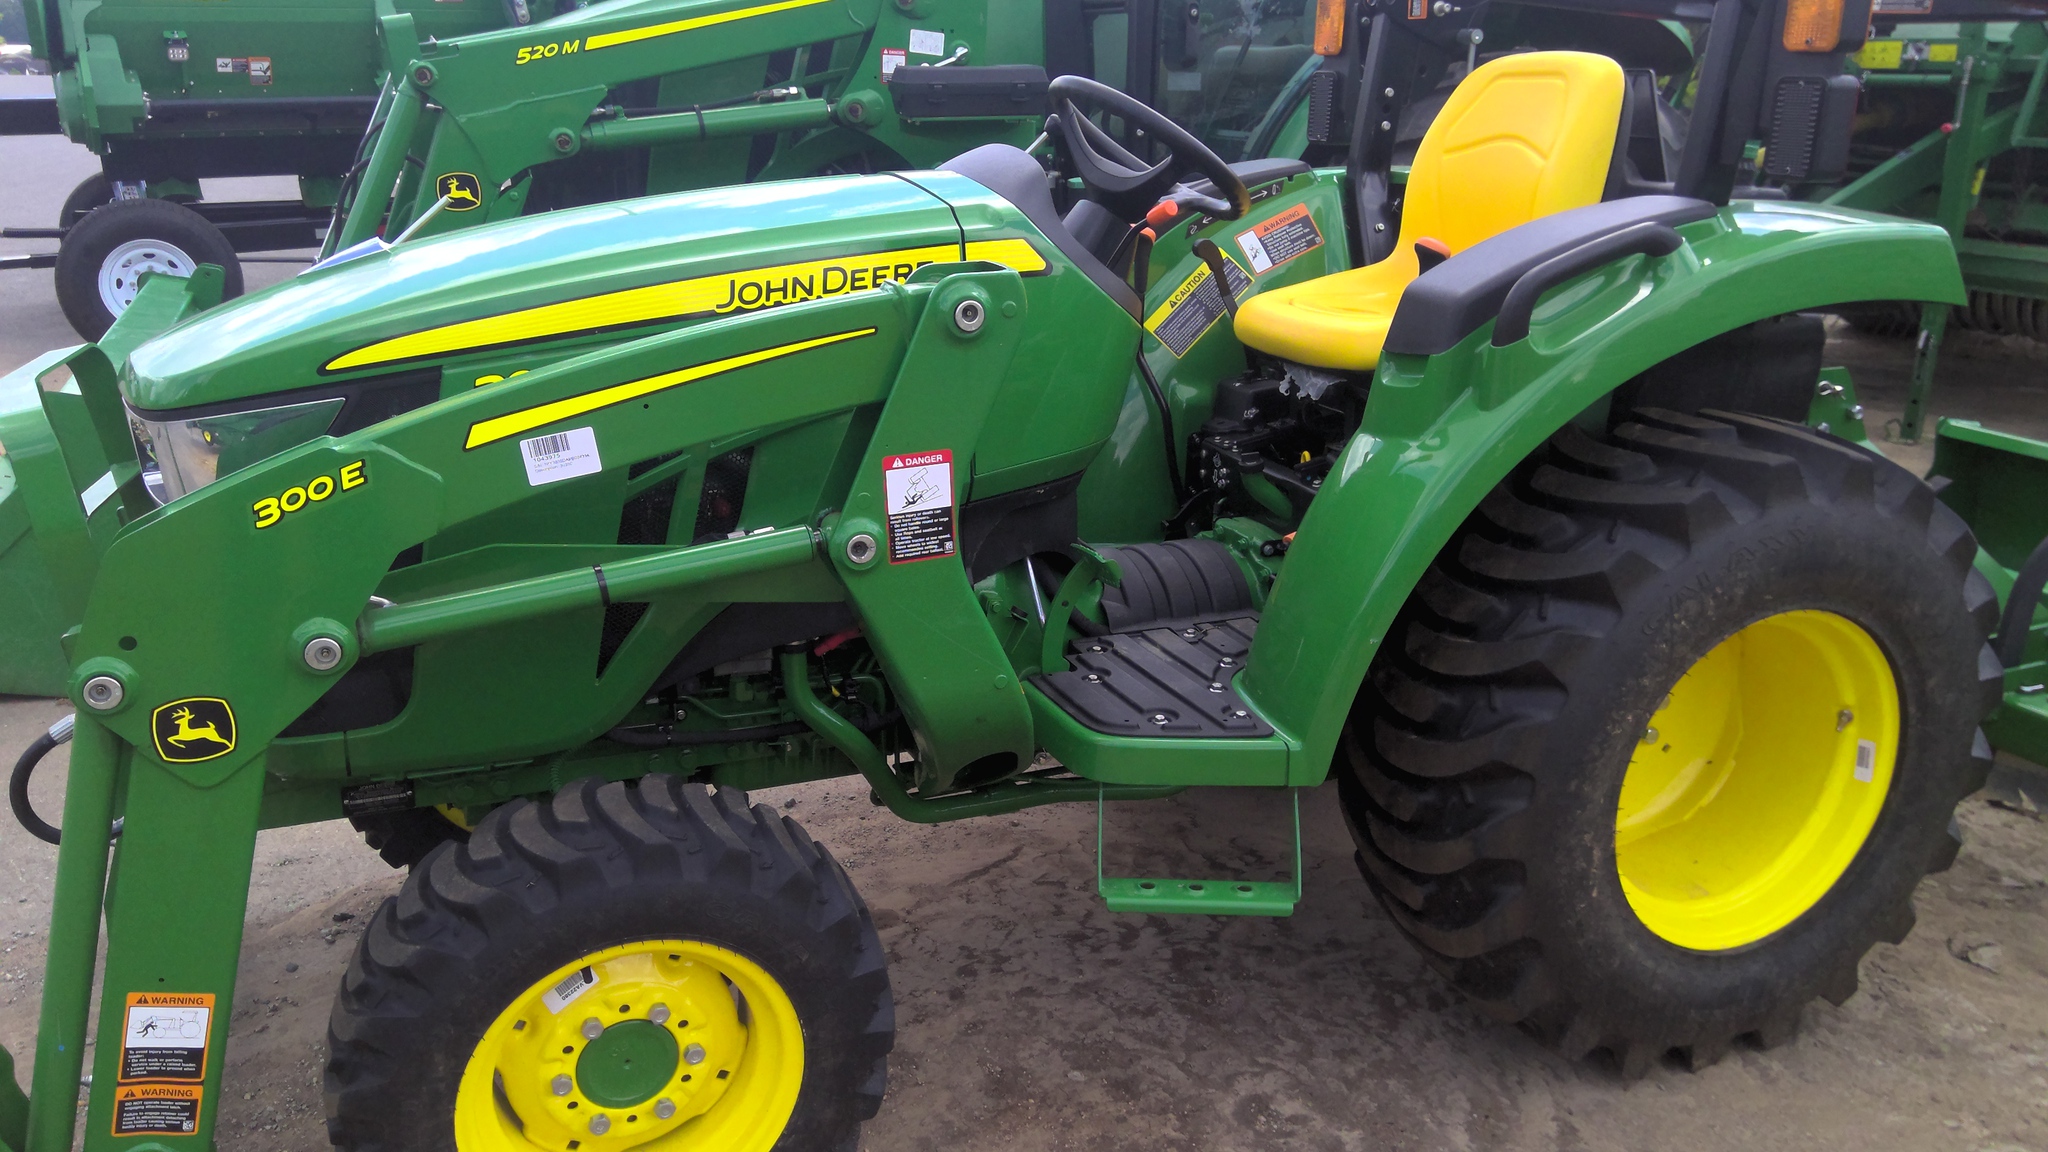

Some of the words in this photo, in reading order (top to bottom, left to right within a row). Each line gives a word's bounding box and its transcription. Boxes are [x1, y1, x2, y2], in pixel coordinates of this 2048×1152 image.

[516, 43, 559, 64] 520
[562, 40, 580, 54] M
[1269, 211, 1300, 229] WARNING
[716, 274, 814, 309] JOHN
[822, 261, 934, 293] DEER
[1175, 270, 1206, 302] CAUTION
[906, 454, 943, 466] DANGER
[253, 475, 336, 529] 300
[340, 460, 367, 492] E
